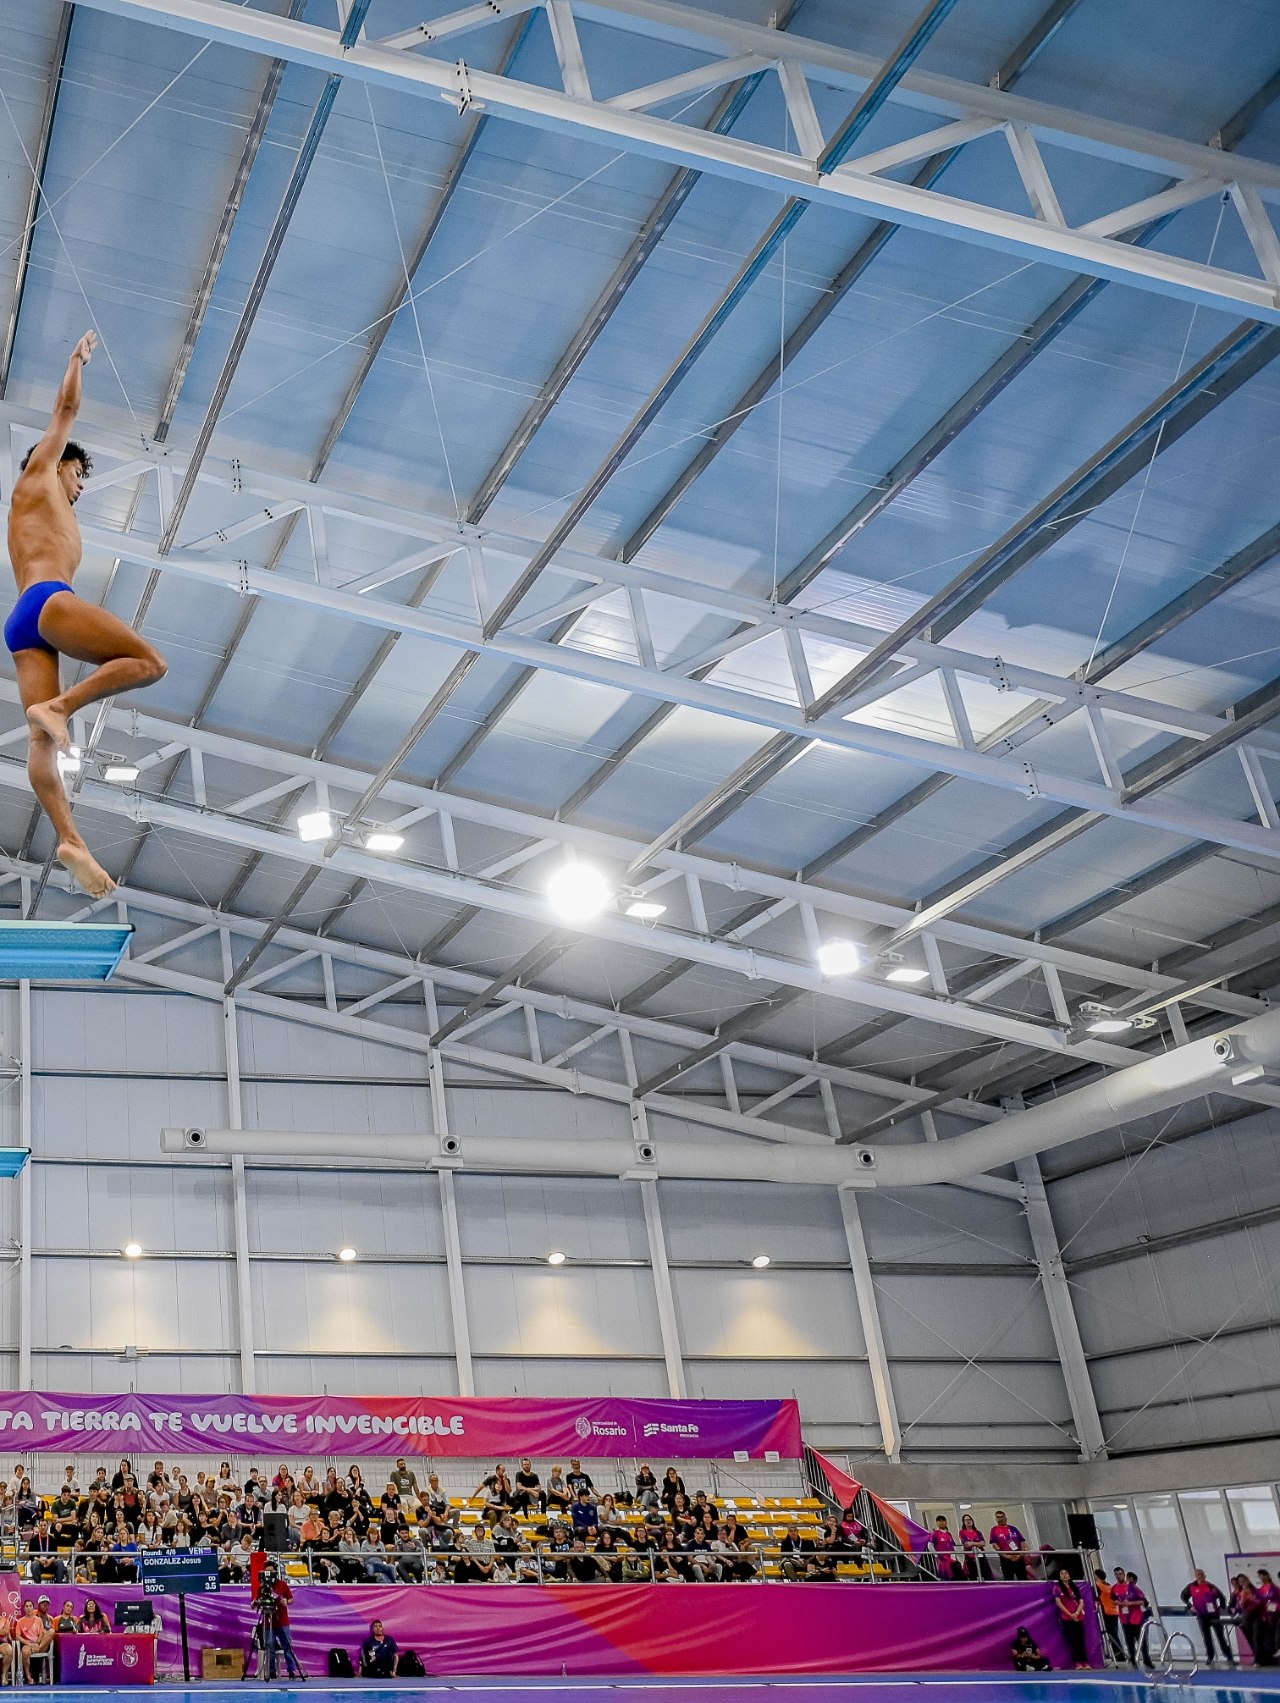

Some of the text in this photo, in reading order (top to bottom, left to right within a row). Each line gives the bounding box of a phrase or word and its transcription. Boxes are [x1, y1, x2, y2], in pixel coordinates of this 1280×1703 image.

[41, 1411, 142, 1431] TIERRA
[148, 1412, 183, 1432] TE
[190, 1413, 298, 1433] VUELVE
[305, 1415, 465, 1436] INVENCIBLE
[660, 1423, 699, 1433] Santa Fe
[593, 1425, 627, 1436] Rosario
[142, 1549, 163, 1557] Round:
[188, 1547, 204, 1555] VEN
[143, 1558, 181, 1566] GONZALEZ
[144, 1584, 165, 1593] 307C
[204, 1582, 217, 1590] 3.5
